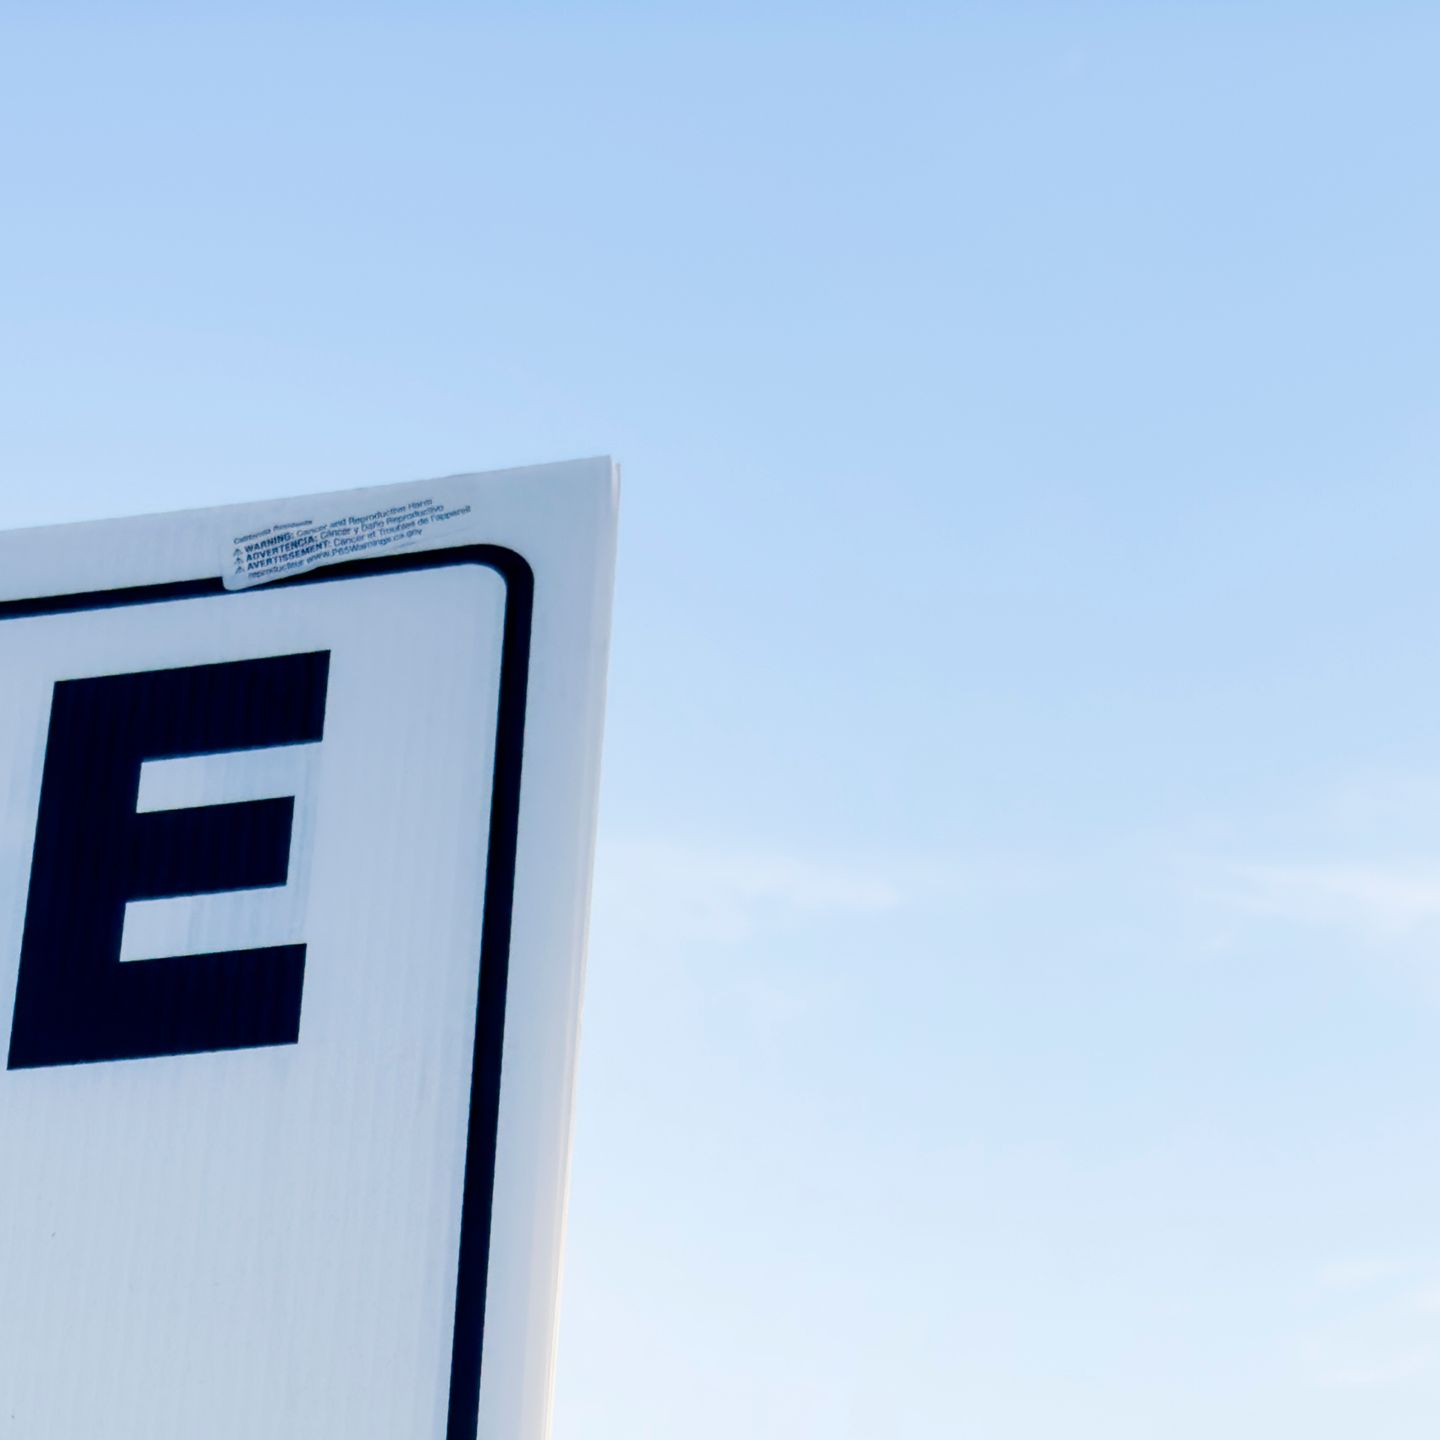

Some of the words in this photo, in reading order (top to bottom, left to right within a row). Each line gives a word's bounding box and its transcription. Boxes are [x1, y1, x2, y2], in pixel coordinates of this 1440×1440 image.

[244, 531, 292, 553] WARNING:
[247, 536, 317, 562] ADVERTENCIA:
[247, 540, 330, 570] AVERTISSEMENT:
